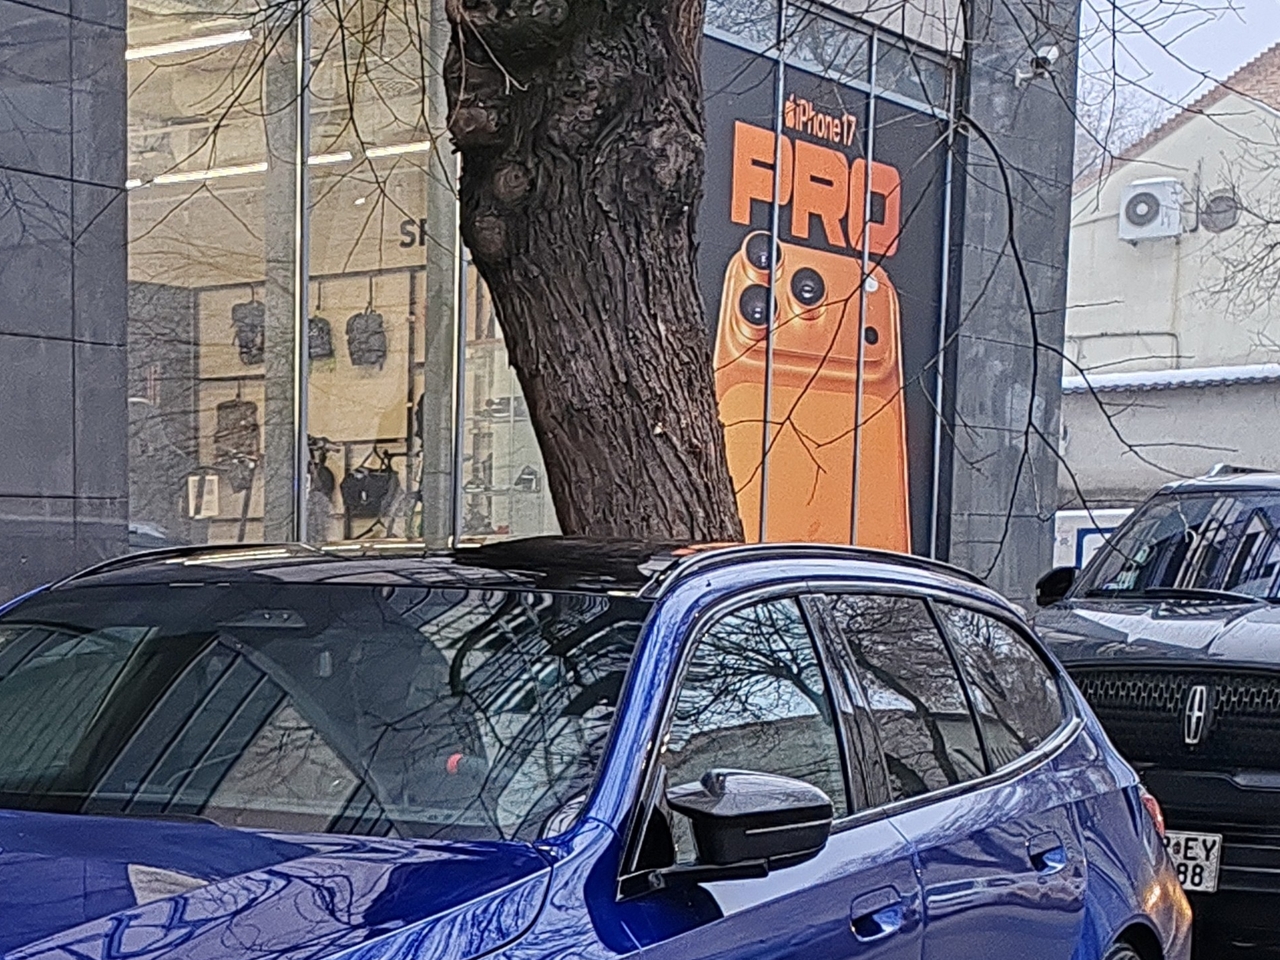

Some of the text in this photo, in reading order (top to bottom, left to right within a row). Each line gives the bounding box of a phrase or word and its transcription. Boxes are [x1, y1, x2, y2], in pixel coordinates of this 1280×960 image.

[795, 98, 857, 146] iPhone 17
[731, 120, 902, 257] PRO
